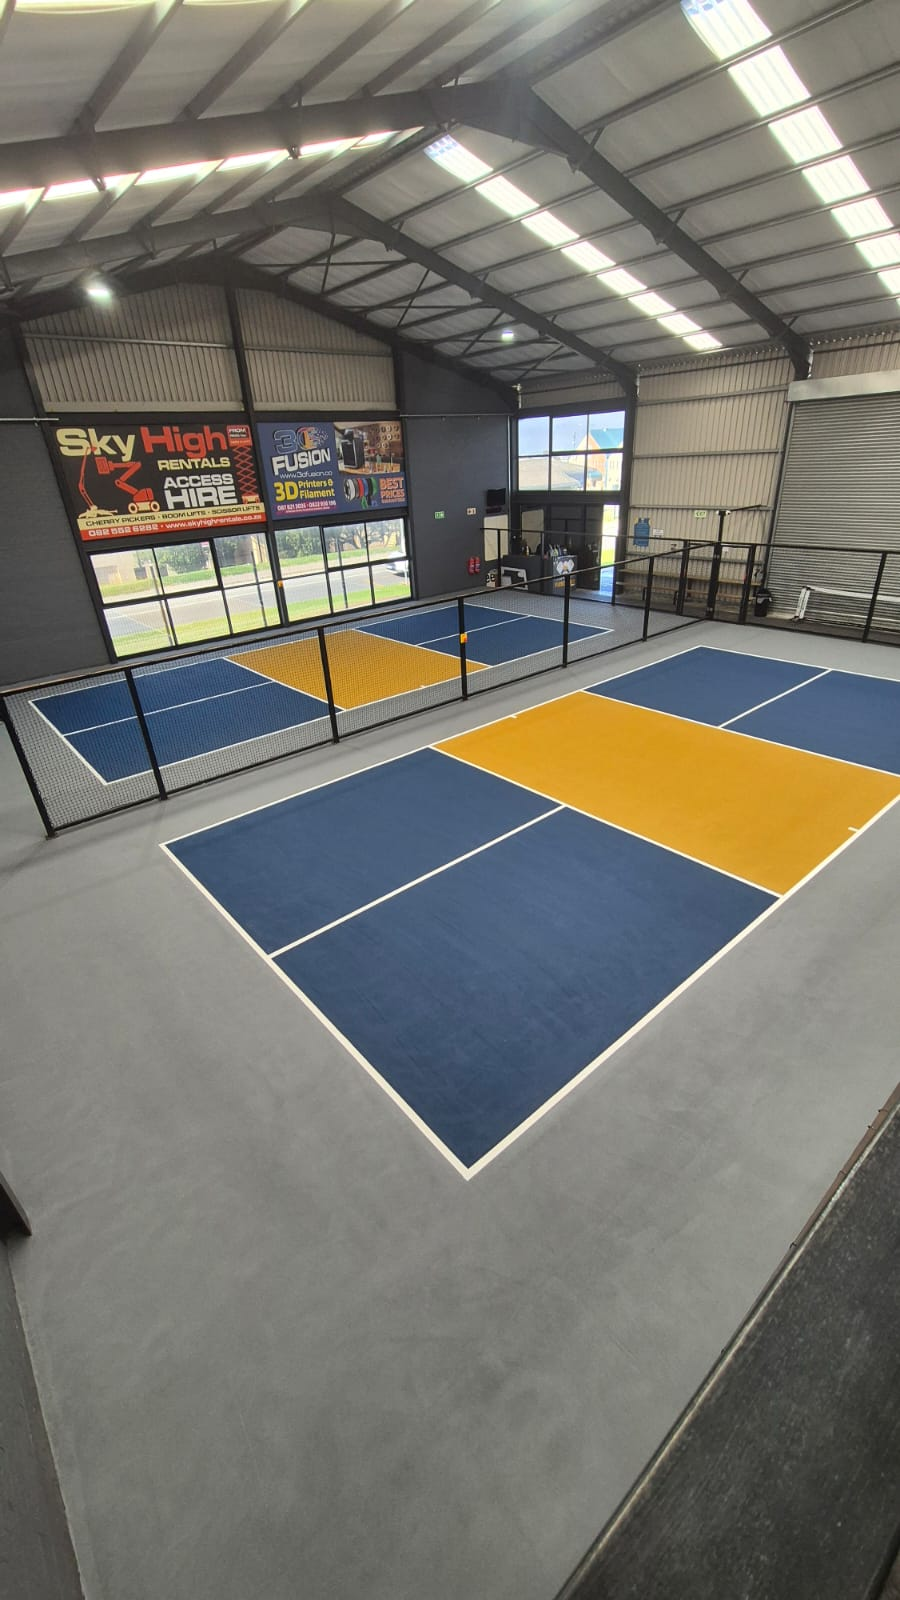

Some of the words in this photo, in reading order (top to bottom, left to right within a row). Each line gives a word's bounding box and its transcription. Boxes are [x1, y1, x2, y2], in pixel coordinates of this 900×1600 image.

[56, 428, 136, 462] Sky
[140, 425, 228, 459] High
[157, 457, 231, 471] RENTALS
[272, 448, 331, 476] FUSION
[164, 473, 234, 489] ACCESS
[298, 480, 327, 489] Printers
[379, 477, 405, 490] BEST
[164, 485, 238, 510] HIRE
[273, 481, 299, 502] 3D
[299, 488, 335, 500] Filament
[380, 489, 405, 499] PRICES
[86, 518, 121, 527] CHERRY
[121, 514, 156, 523] PICKERS
[161, 511, 186, 519] BOOM
